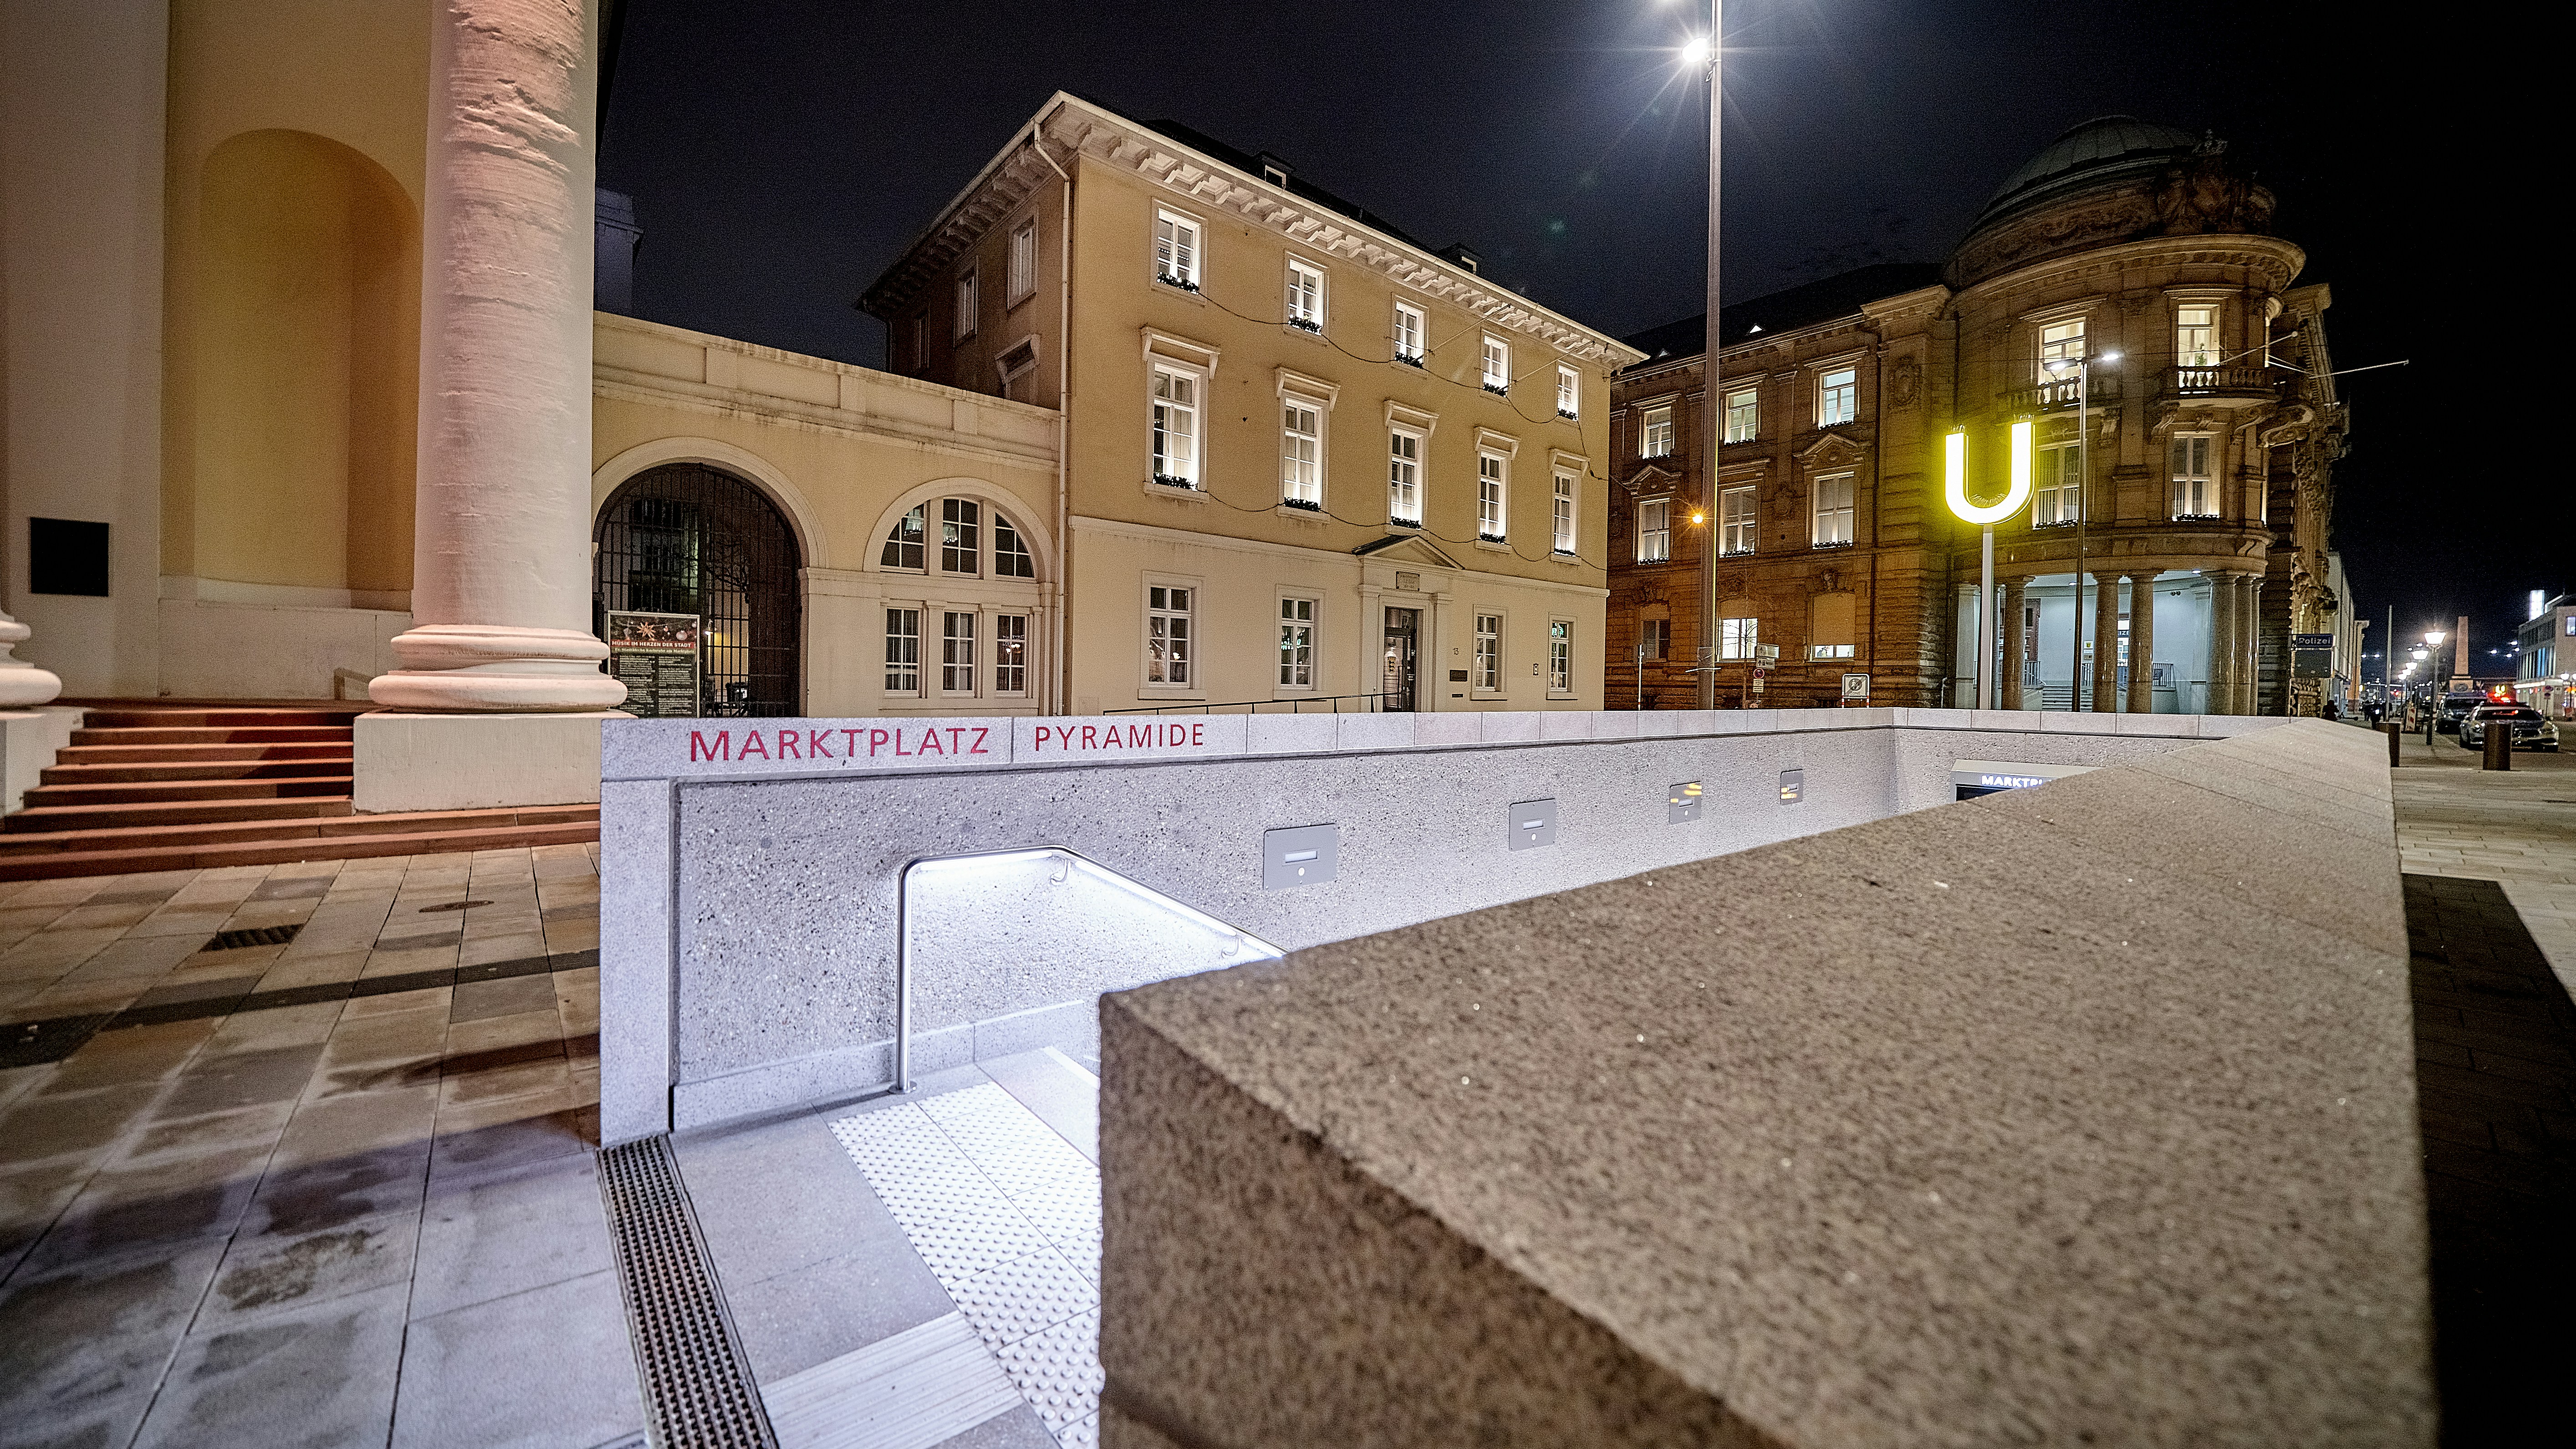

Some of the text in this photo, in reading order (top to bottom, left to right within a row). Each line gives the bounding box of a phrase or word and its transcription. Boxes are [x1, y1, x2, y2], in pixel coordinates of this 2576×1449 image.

[1945, 421, 2035, 525] U
[691, 728, 989, 762] MARKTPLATZ
[1036, 724, 1204, 751] PYRAMIDE
[1981, 775, 2042, 788] MARKTP
